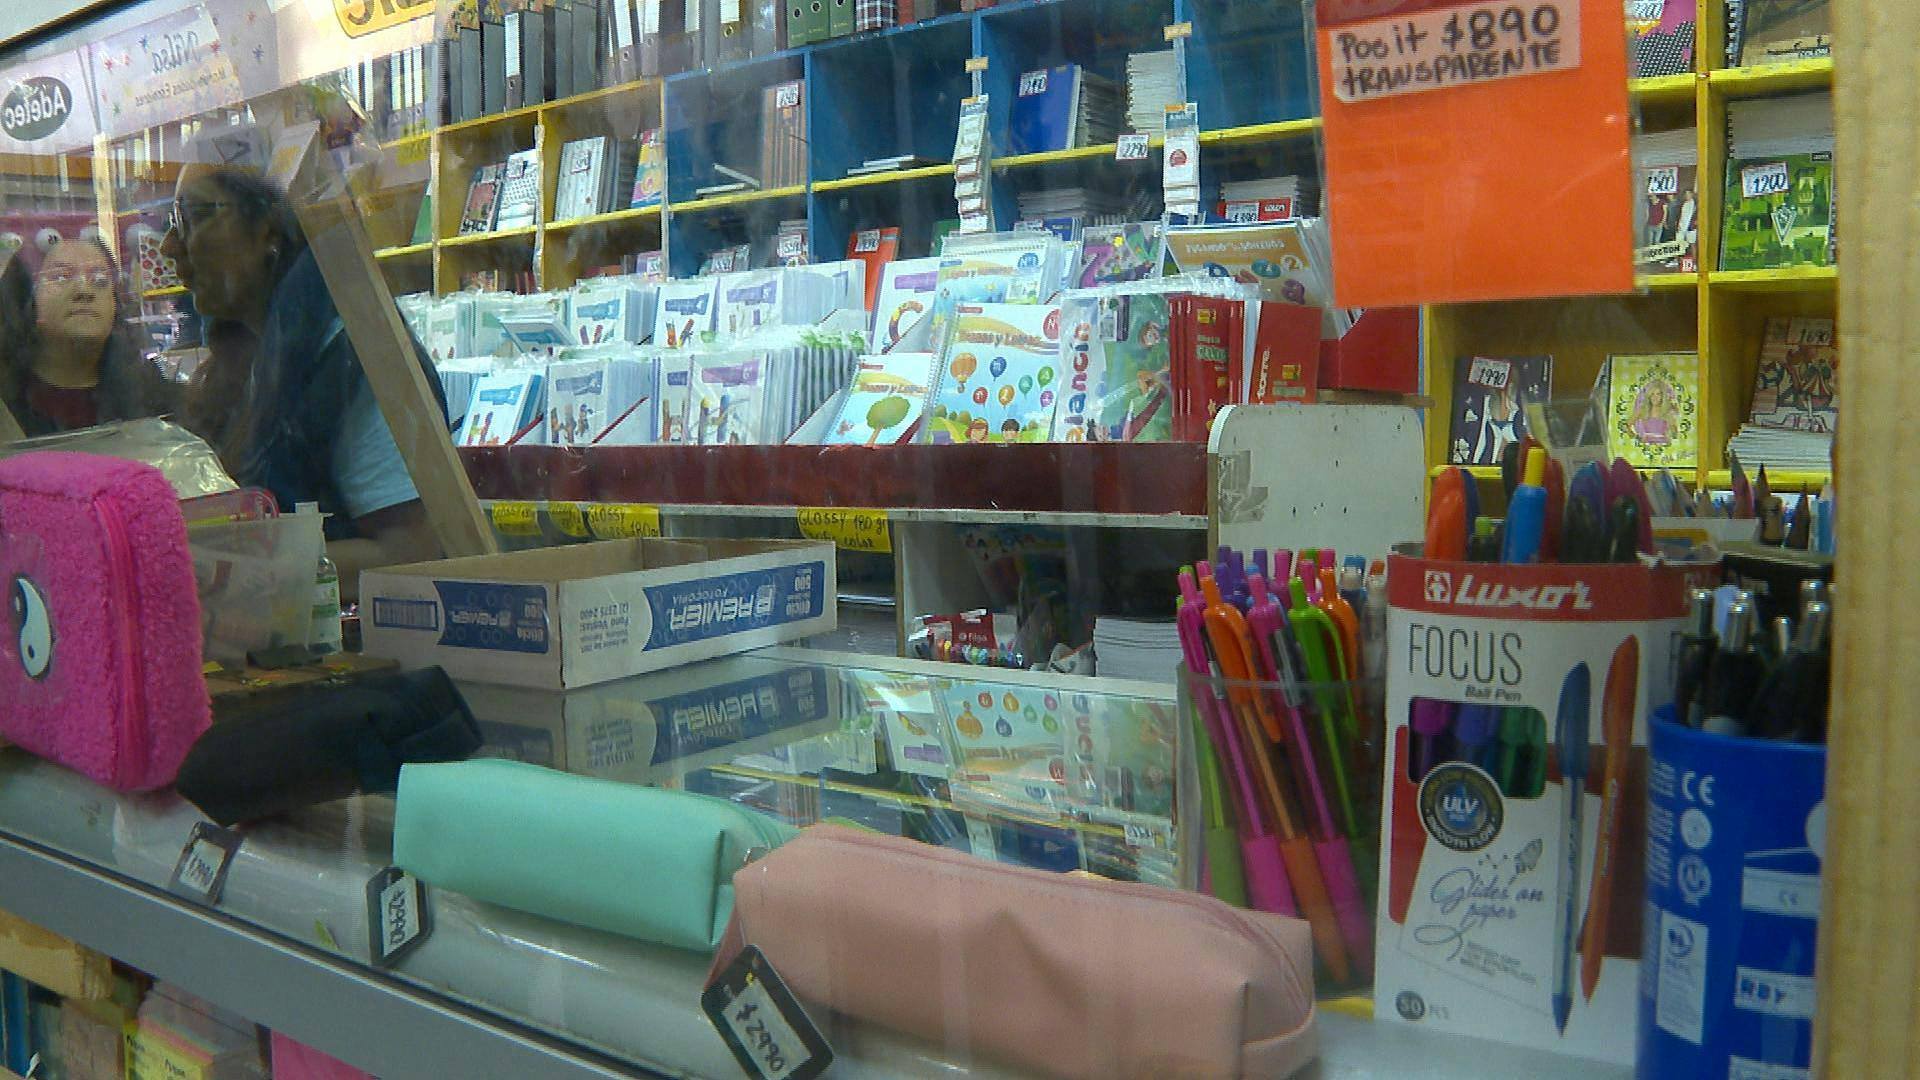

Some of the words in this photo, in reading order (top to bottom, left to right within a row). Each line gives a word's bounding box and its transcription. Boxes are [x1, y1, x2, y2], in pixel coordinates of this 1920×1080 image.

[1393, 21, 1428, 53] it
[1441, 4, 1559, 51] $890
[1753, 172, 1786, 193] 1200
[1480, 367, 1506, 385] 1990
[799, 509, 848, 529] GLOSSY
[669, 585, 776, 635] PREMIER
[1409, 622, 1523, 685] FOCUS
[1465, 685, 1491, 699] Ball
[1495, 687, 1522, 701] Pen
[1442, 796, 1479, 815] ULV
